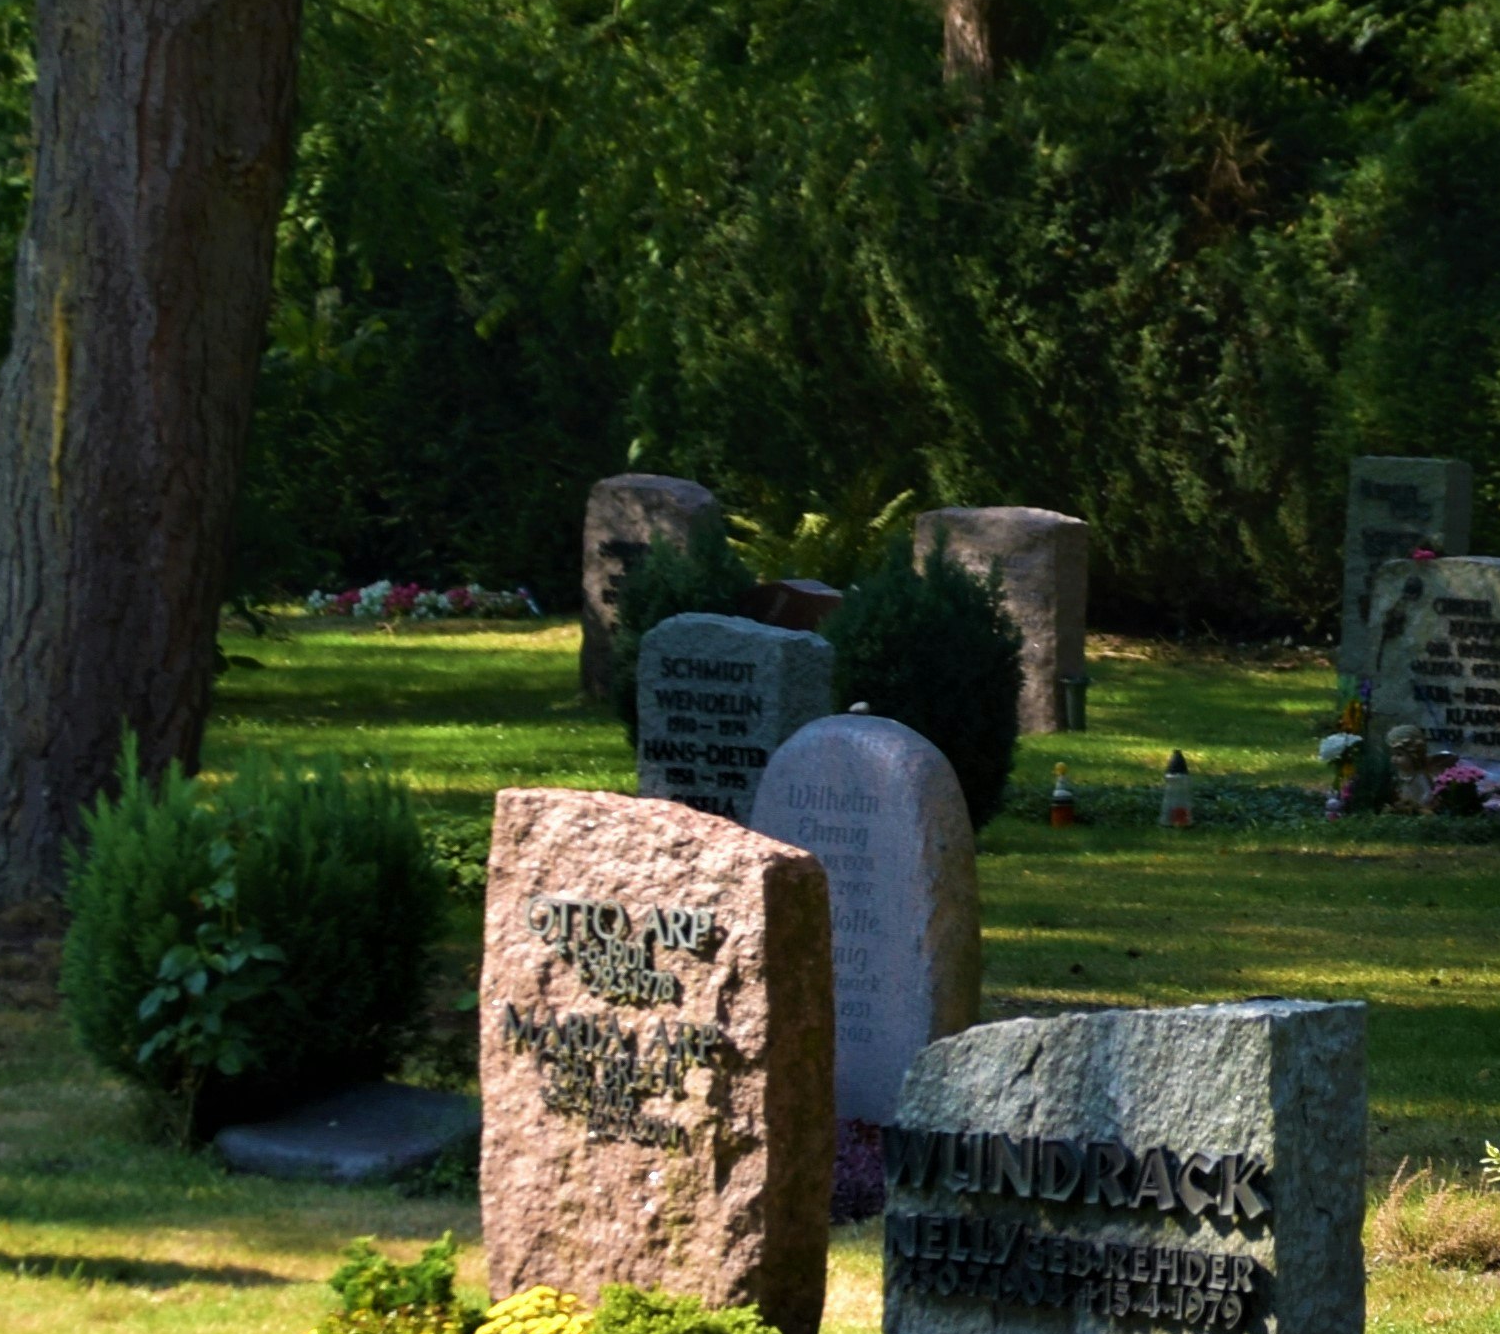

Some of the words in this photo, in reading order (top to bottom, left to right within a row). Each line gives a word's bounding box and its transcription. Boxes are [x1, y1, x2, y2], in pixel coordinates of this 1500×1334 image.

[660, 656, 756, 682] SCHMIDT
[655, 689, 762, 716] WENDELIN
[643, 739, 767, 769] HANS-DIETER
[788, 783, 880, 816] Wilhelm
[798, 817, 868, 854] Ehmig
[527, 896, 627, 941] OTTO
[640, 903, 712, 950] ARP
[500, 1000, 628, 1055] MARIA
[645, 1016, 719, 1065] ARP
[881, 1124, 1272, 1220] WUNDRACK
[885, 1211, 1023, 1266] NELLY
[1104, 1244, 1255, 1294] REHDER
